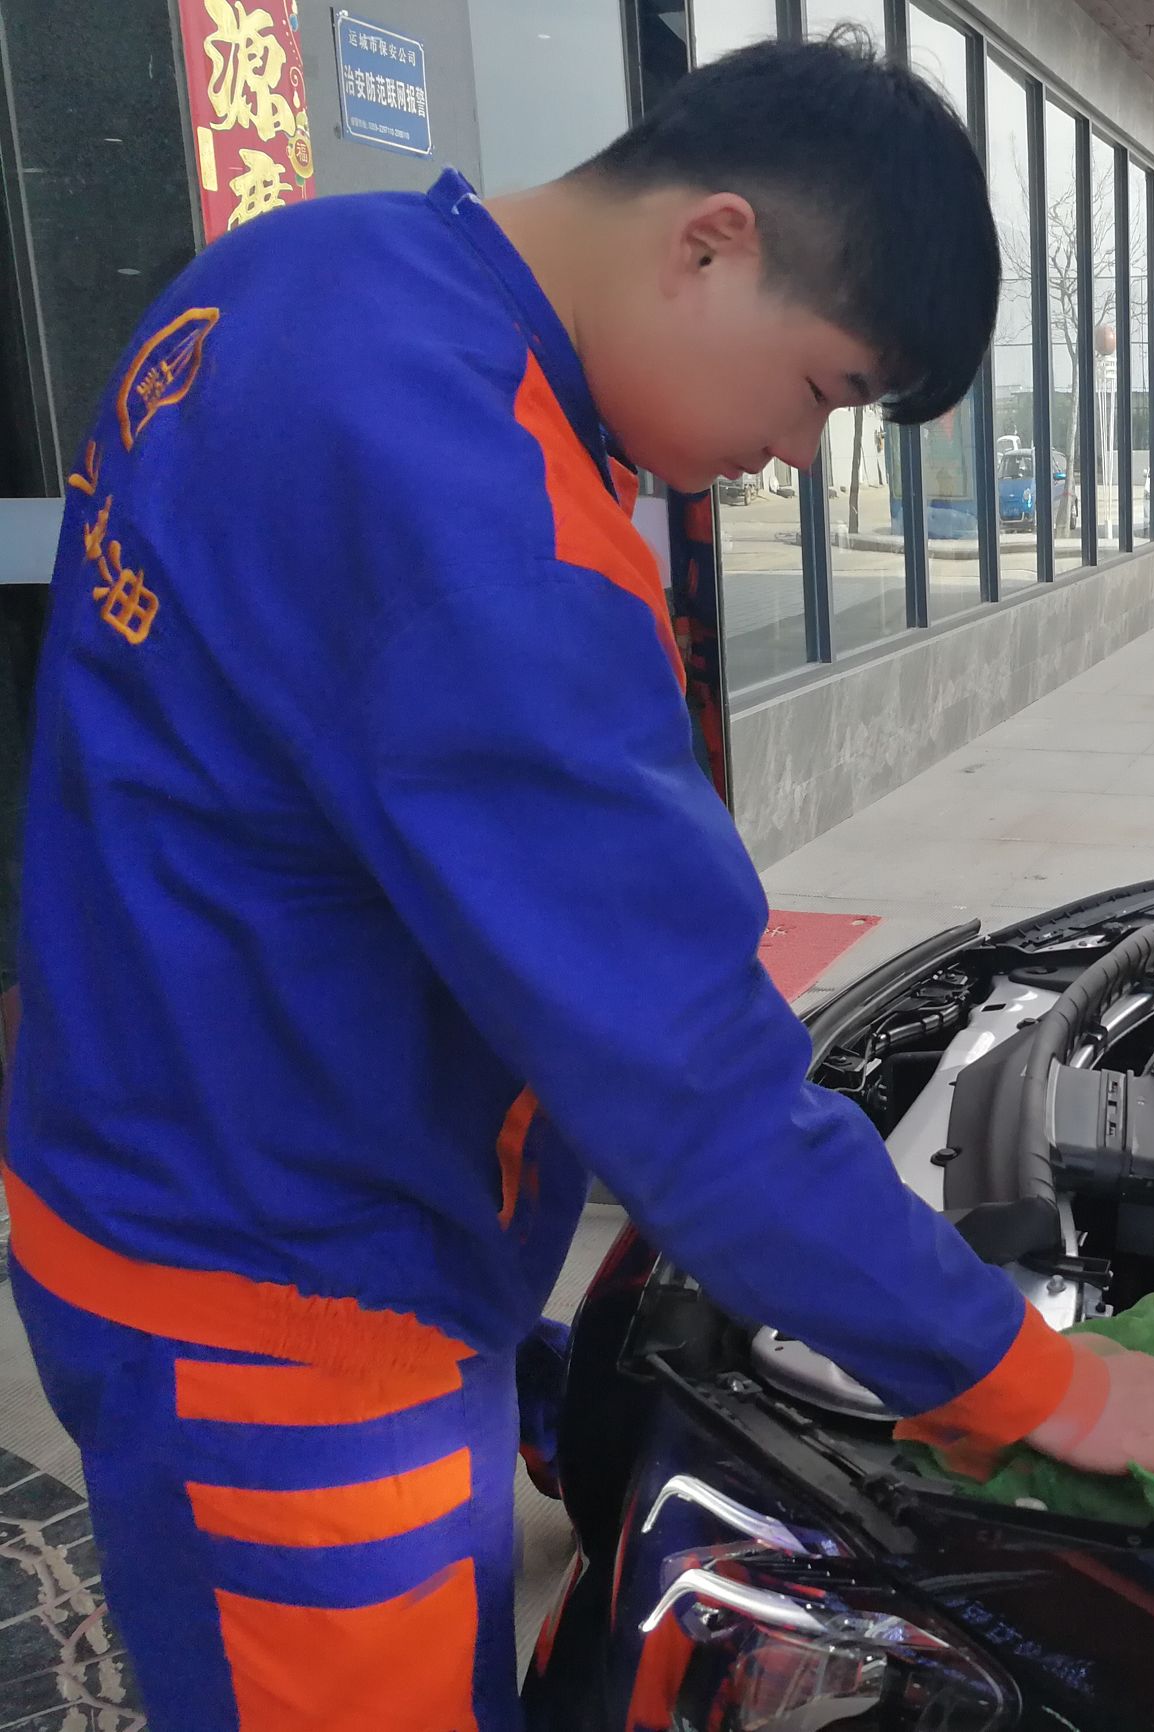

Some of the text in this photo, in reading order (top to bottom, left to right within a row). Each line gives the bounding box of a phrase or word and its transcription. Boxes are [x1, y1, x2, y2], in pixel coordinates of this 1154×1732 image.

[348, 29, 416, 67] 运城市保安公司
[344, 65, 425, 118] 治安防范联网报警
